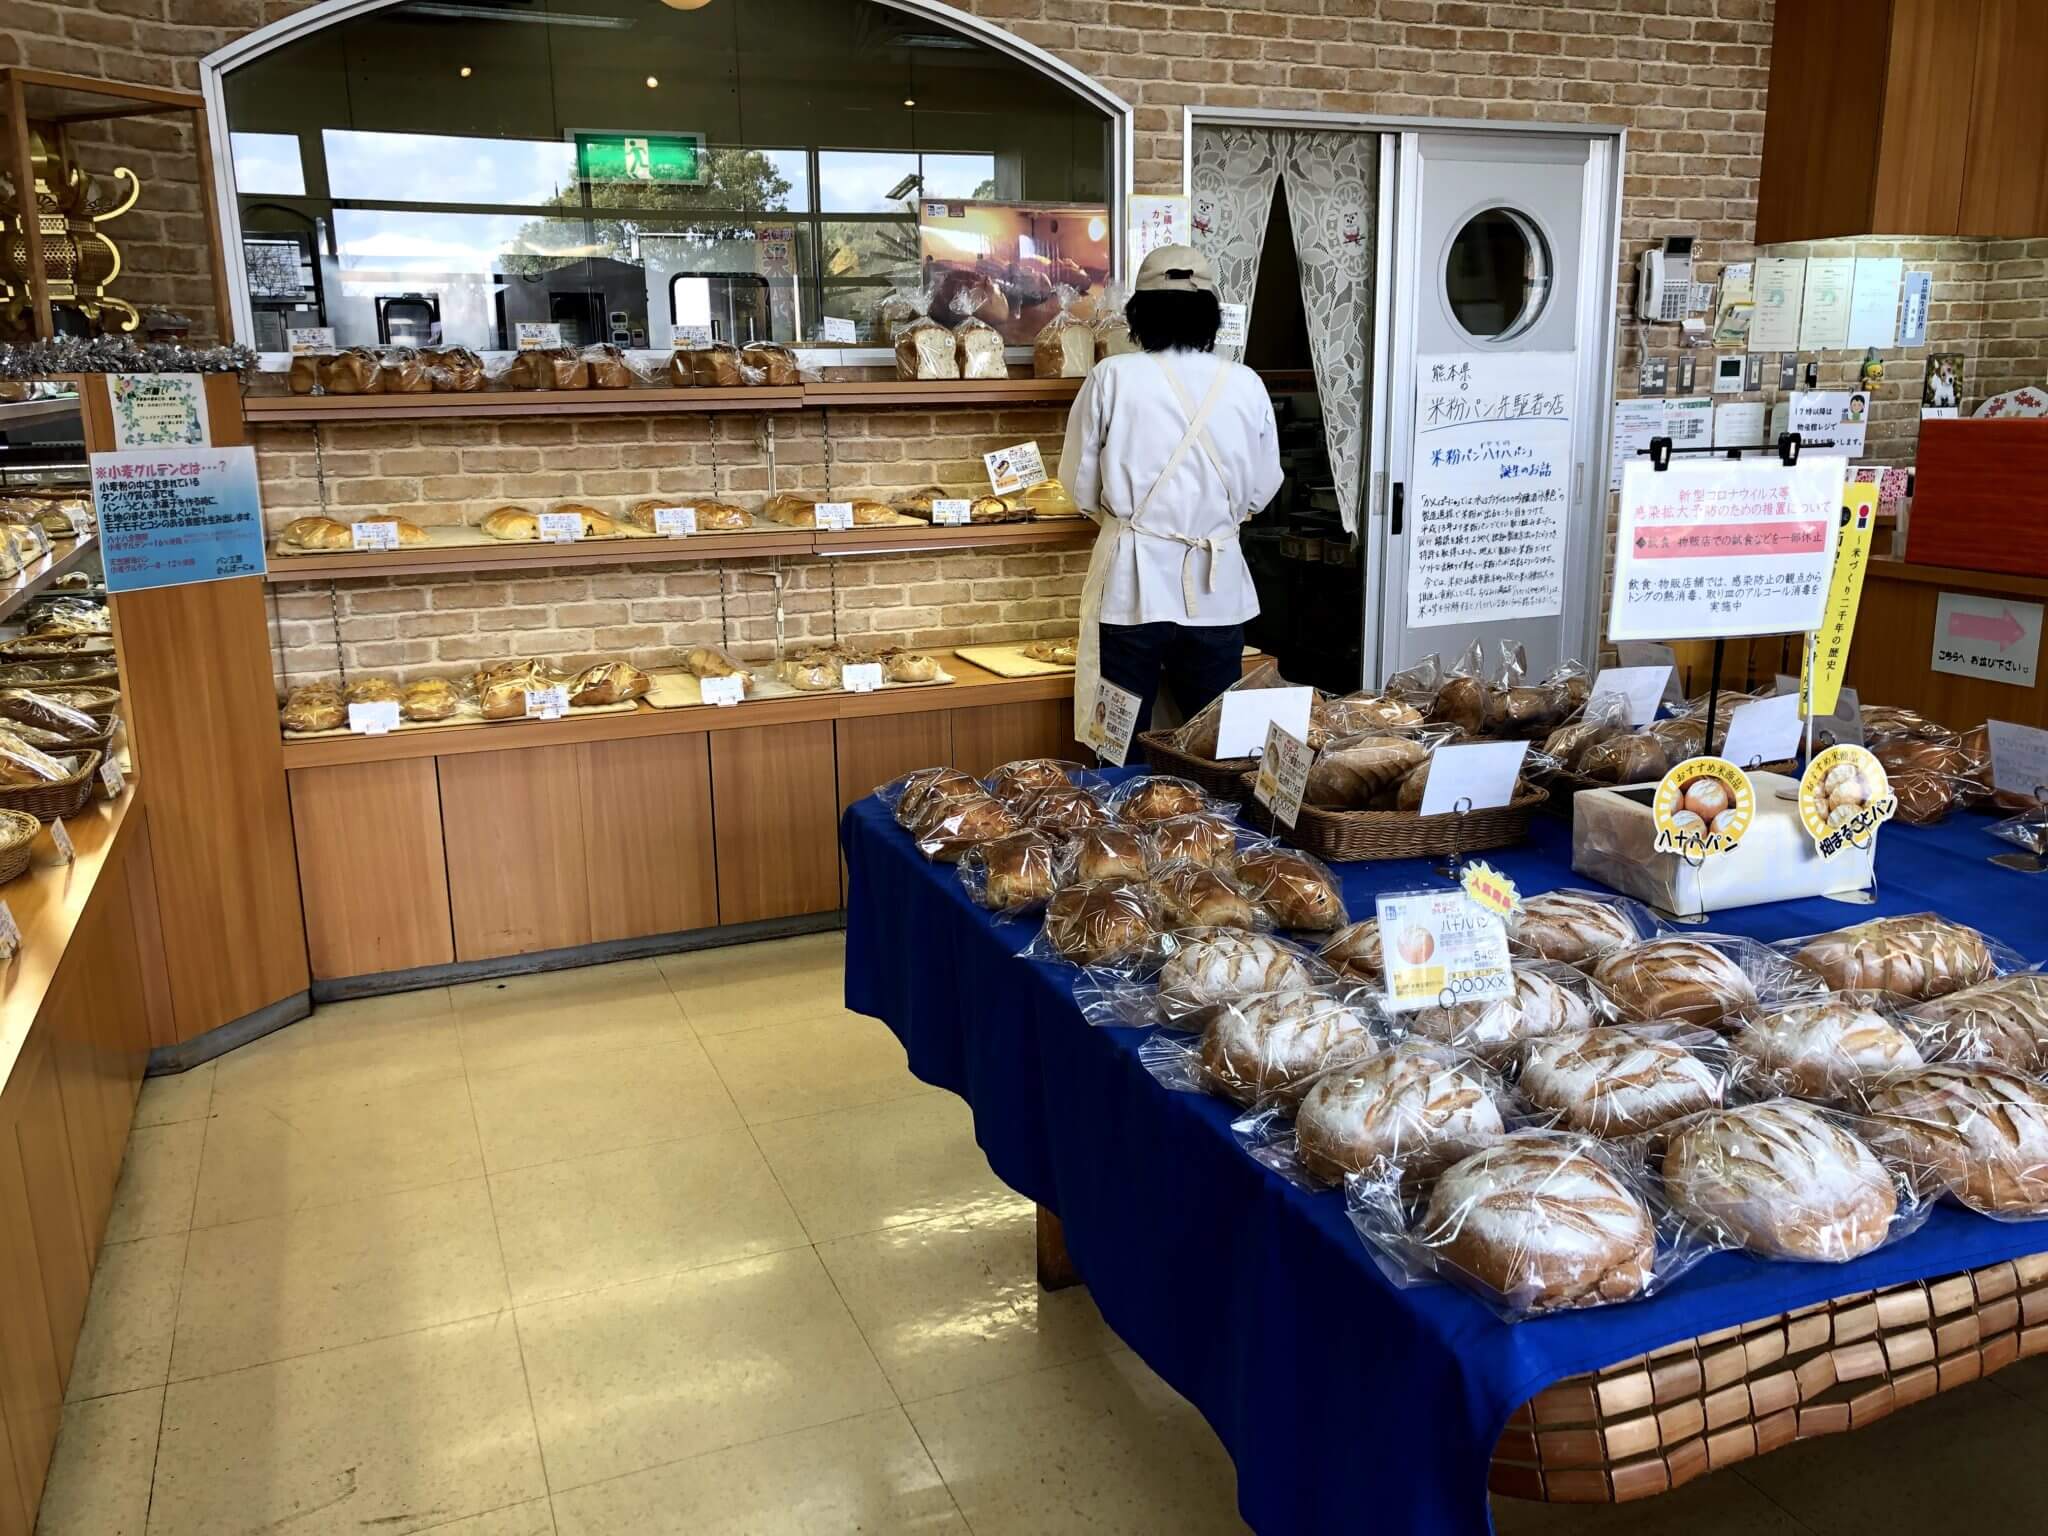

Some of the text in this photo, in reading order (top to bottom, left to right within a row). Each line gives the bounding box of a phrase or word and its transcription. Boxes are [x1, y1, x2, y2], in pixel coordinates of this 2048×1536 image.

[1431, 362, 1472, 383] 熊本県
[1460, 383, 1469, 391] の
[1679, 486, 1790, 503] 新型コロナウイルス等
[1634, 500, 1833, 520] 感染拡大予防のための措置について
[1709, 601, 1743, 613] 実施中
[1938, 650, 2021, 673] こちらへ お並び下さい
[1819, 799, 1894, 858] 畑まるごとパン
